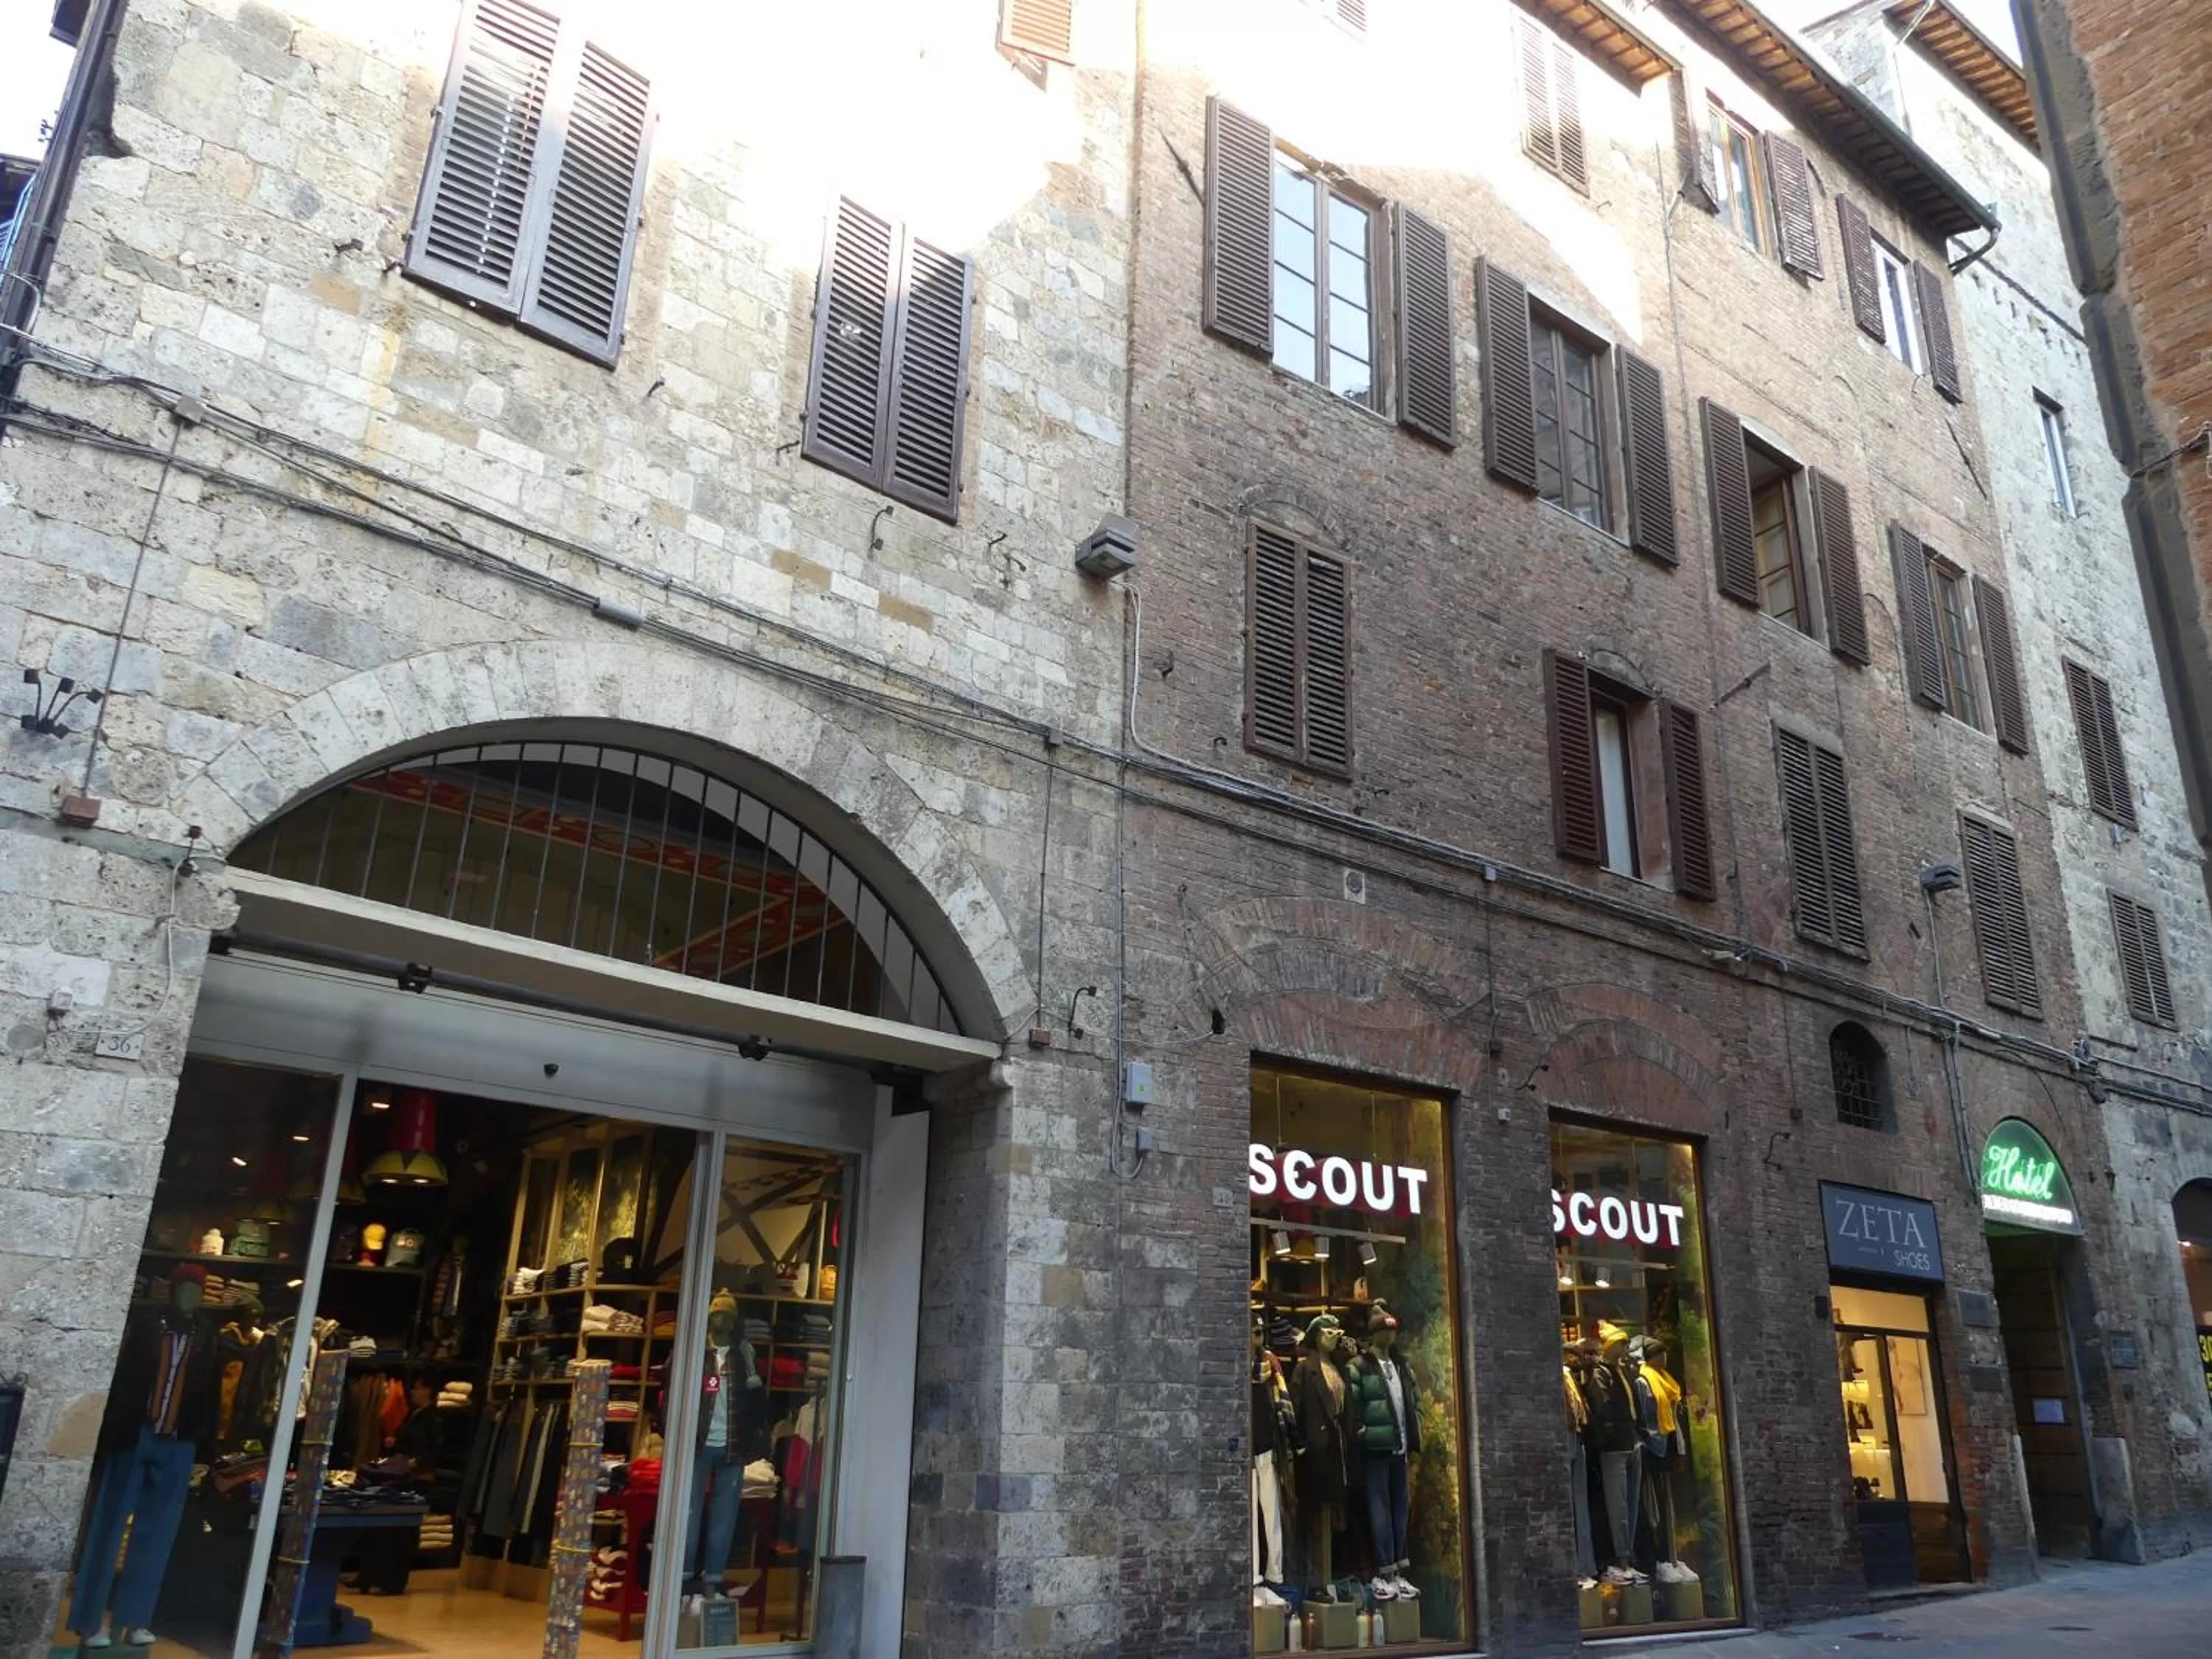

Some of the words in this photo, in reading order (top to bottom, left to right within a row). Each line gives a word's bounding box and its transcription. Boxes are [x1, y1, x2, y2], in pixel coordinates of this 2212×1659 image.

[108, 1035, 131, 1053] 36
[1248, 1144, 1427, 1214] SCOUT
[1988, 1144, 2056, 1200] Hotel
[1834, 1195, 1929, 1248] ZETA
[1893, 1249, 1930, 1271] SHOES
